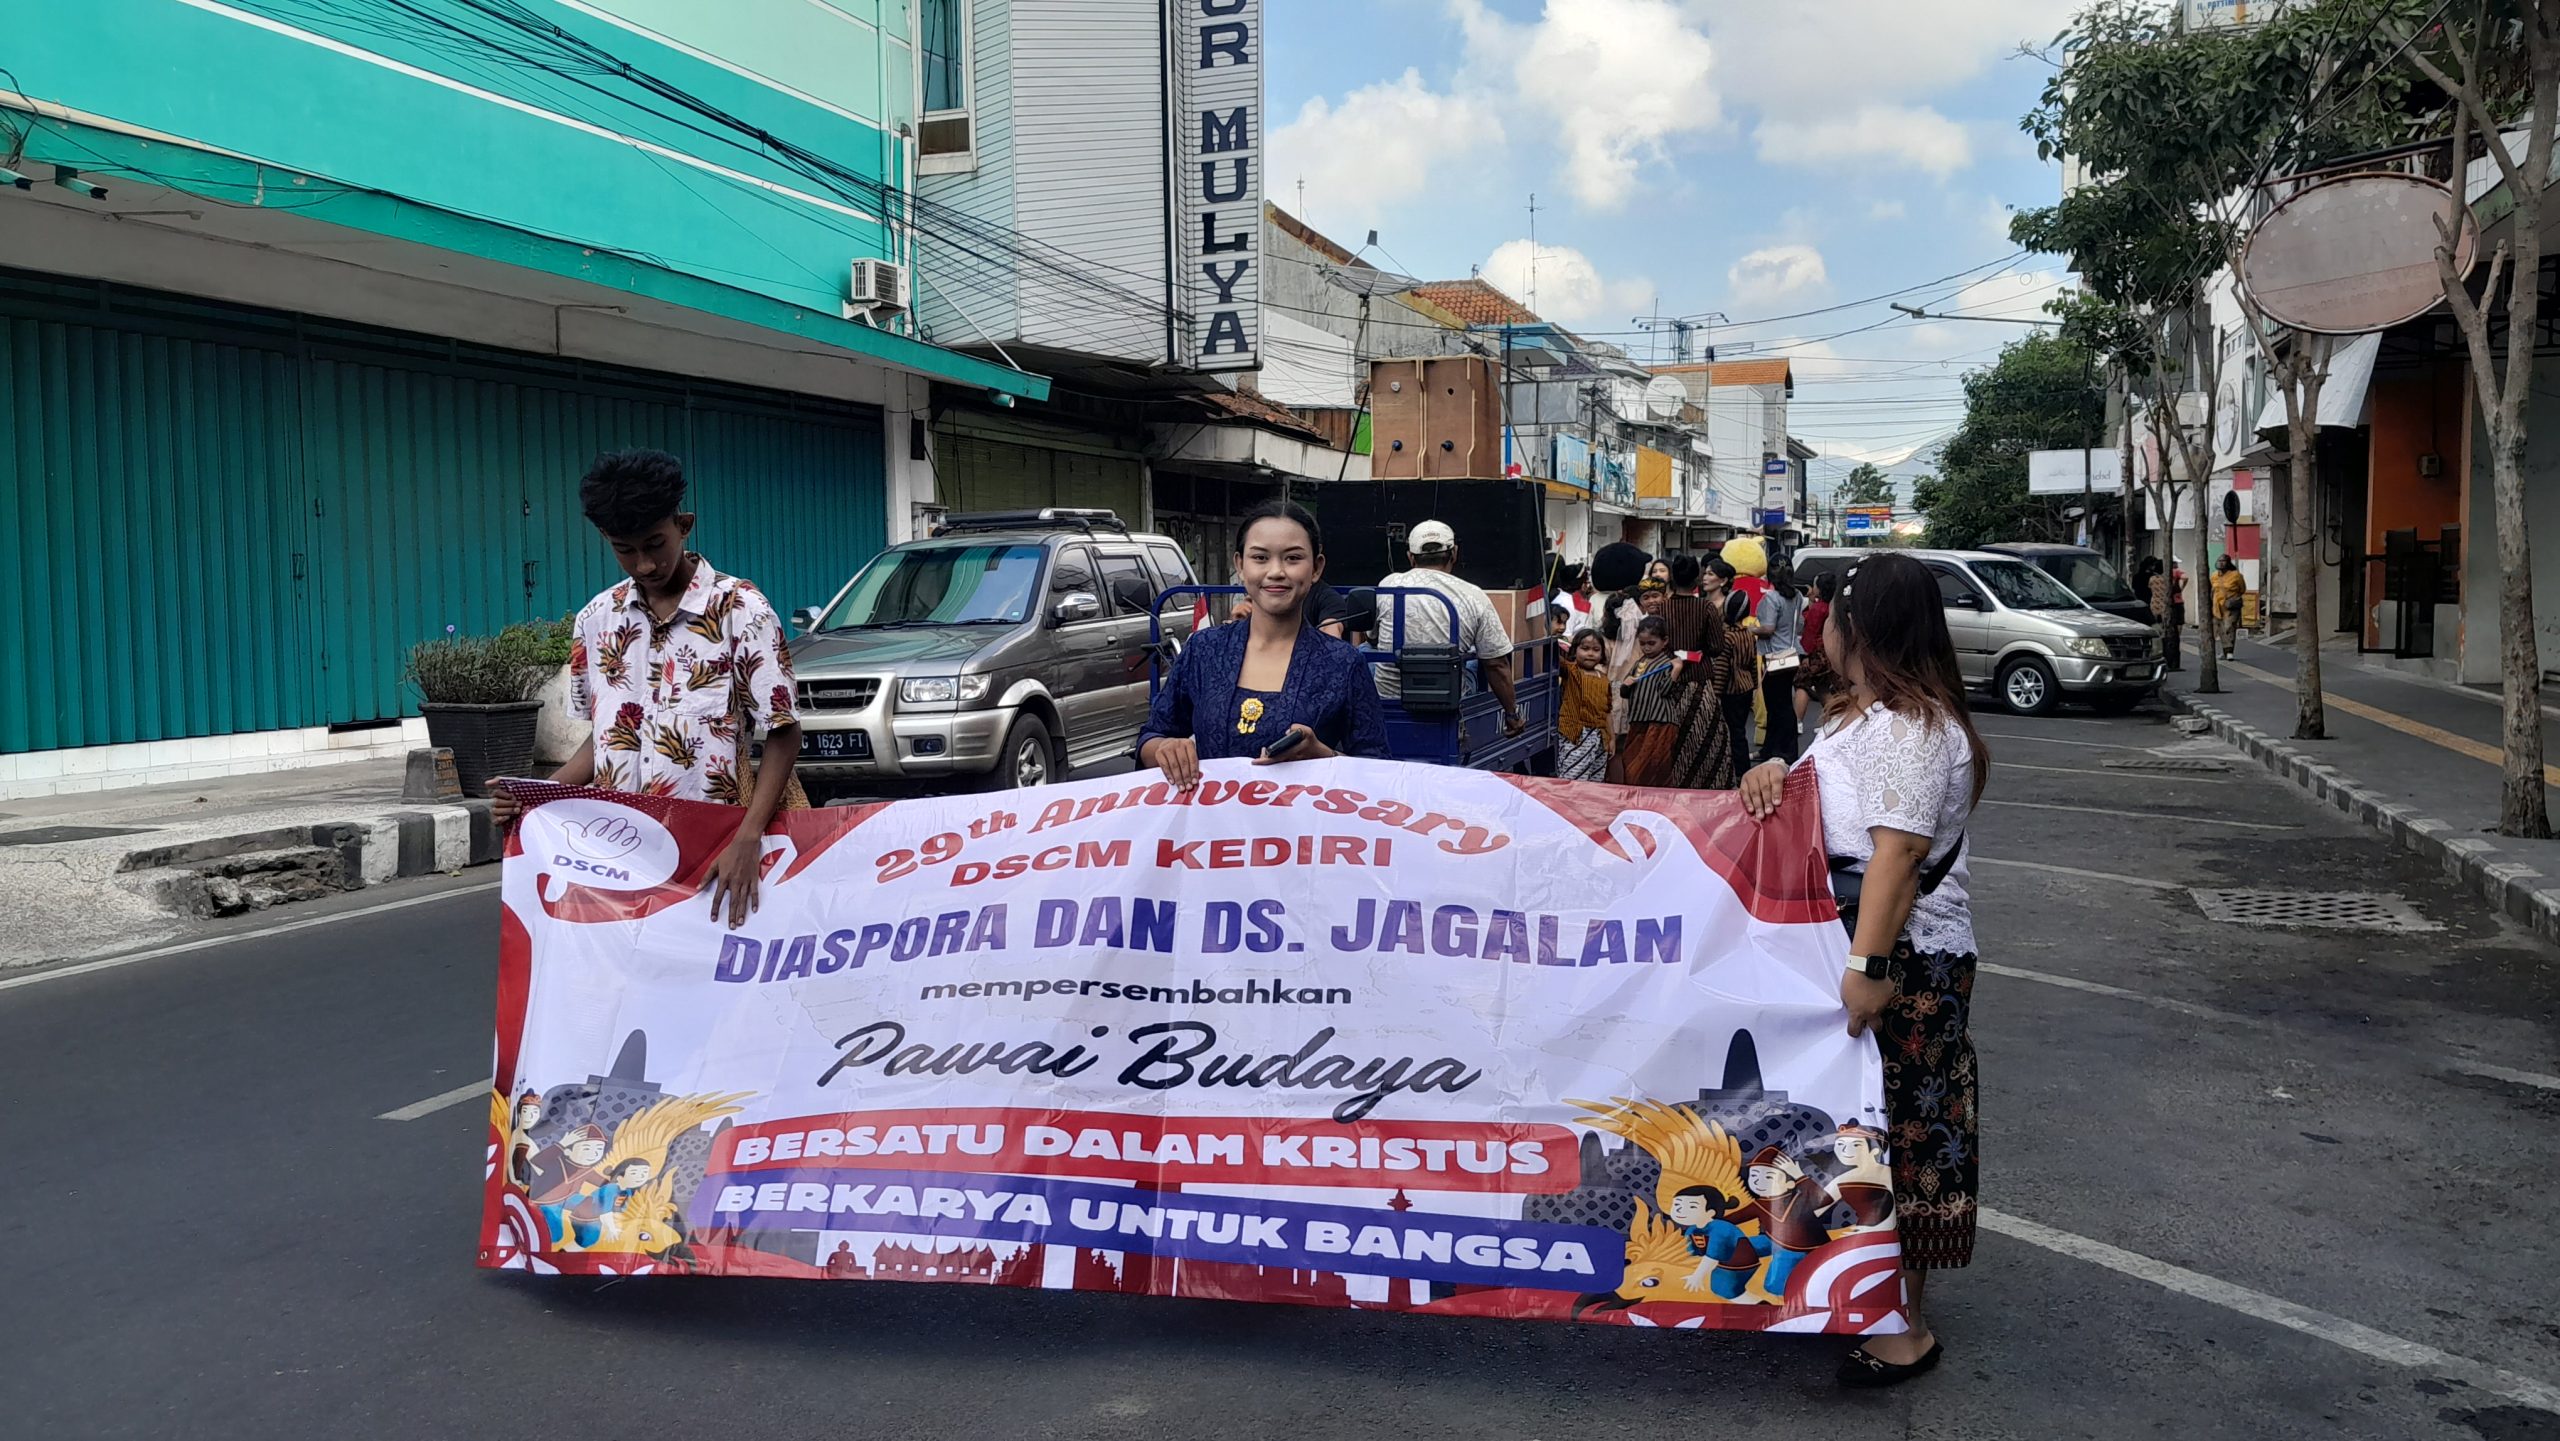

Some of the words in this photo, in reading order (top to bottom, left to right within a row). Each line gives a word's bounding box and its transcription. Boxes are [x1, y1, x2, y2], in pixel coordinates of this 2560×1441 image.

[1200, 107, 1249, 355] MULYA
[816, 734, 843, 749] 1623
[849, 733, 864, 748] FT
[875, 810, 1018, 884] 29th
[1027, 774, 1510, 855] Anniversary
[950, 840, 1132, 887] DSCM
[1156, 836, 1392, 870] KEDIRI
[553, 855, 629, 881] DSCM
[715, 903, 1007, 984] DIASPORA
[1034, 897, 1177, 953] DAN
[1201, 899, 1304, 953] DS.
[1331, 898, 1683, 968] JAGALAN
[920, 978, 1351, 1004] mempersembahkan
[817, 1020, 1109, 1088] Pawai
[1117, 1020, 1483, 1124] Budaya
[733, 1124, 1005, 1166] BERSATU
[1024, 1125, 1244, 1167] DALAM
[1262, 1134, 1550, 1176] KRISTUS
[715, 1182, 1051, 1225] BERKARYA
[1069, 1198, 1288, 1250] UNTUK
[1304, 1220, 1595, 1275] BANGSA
